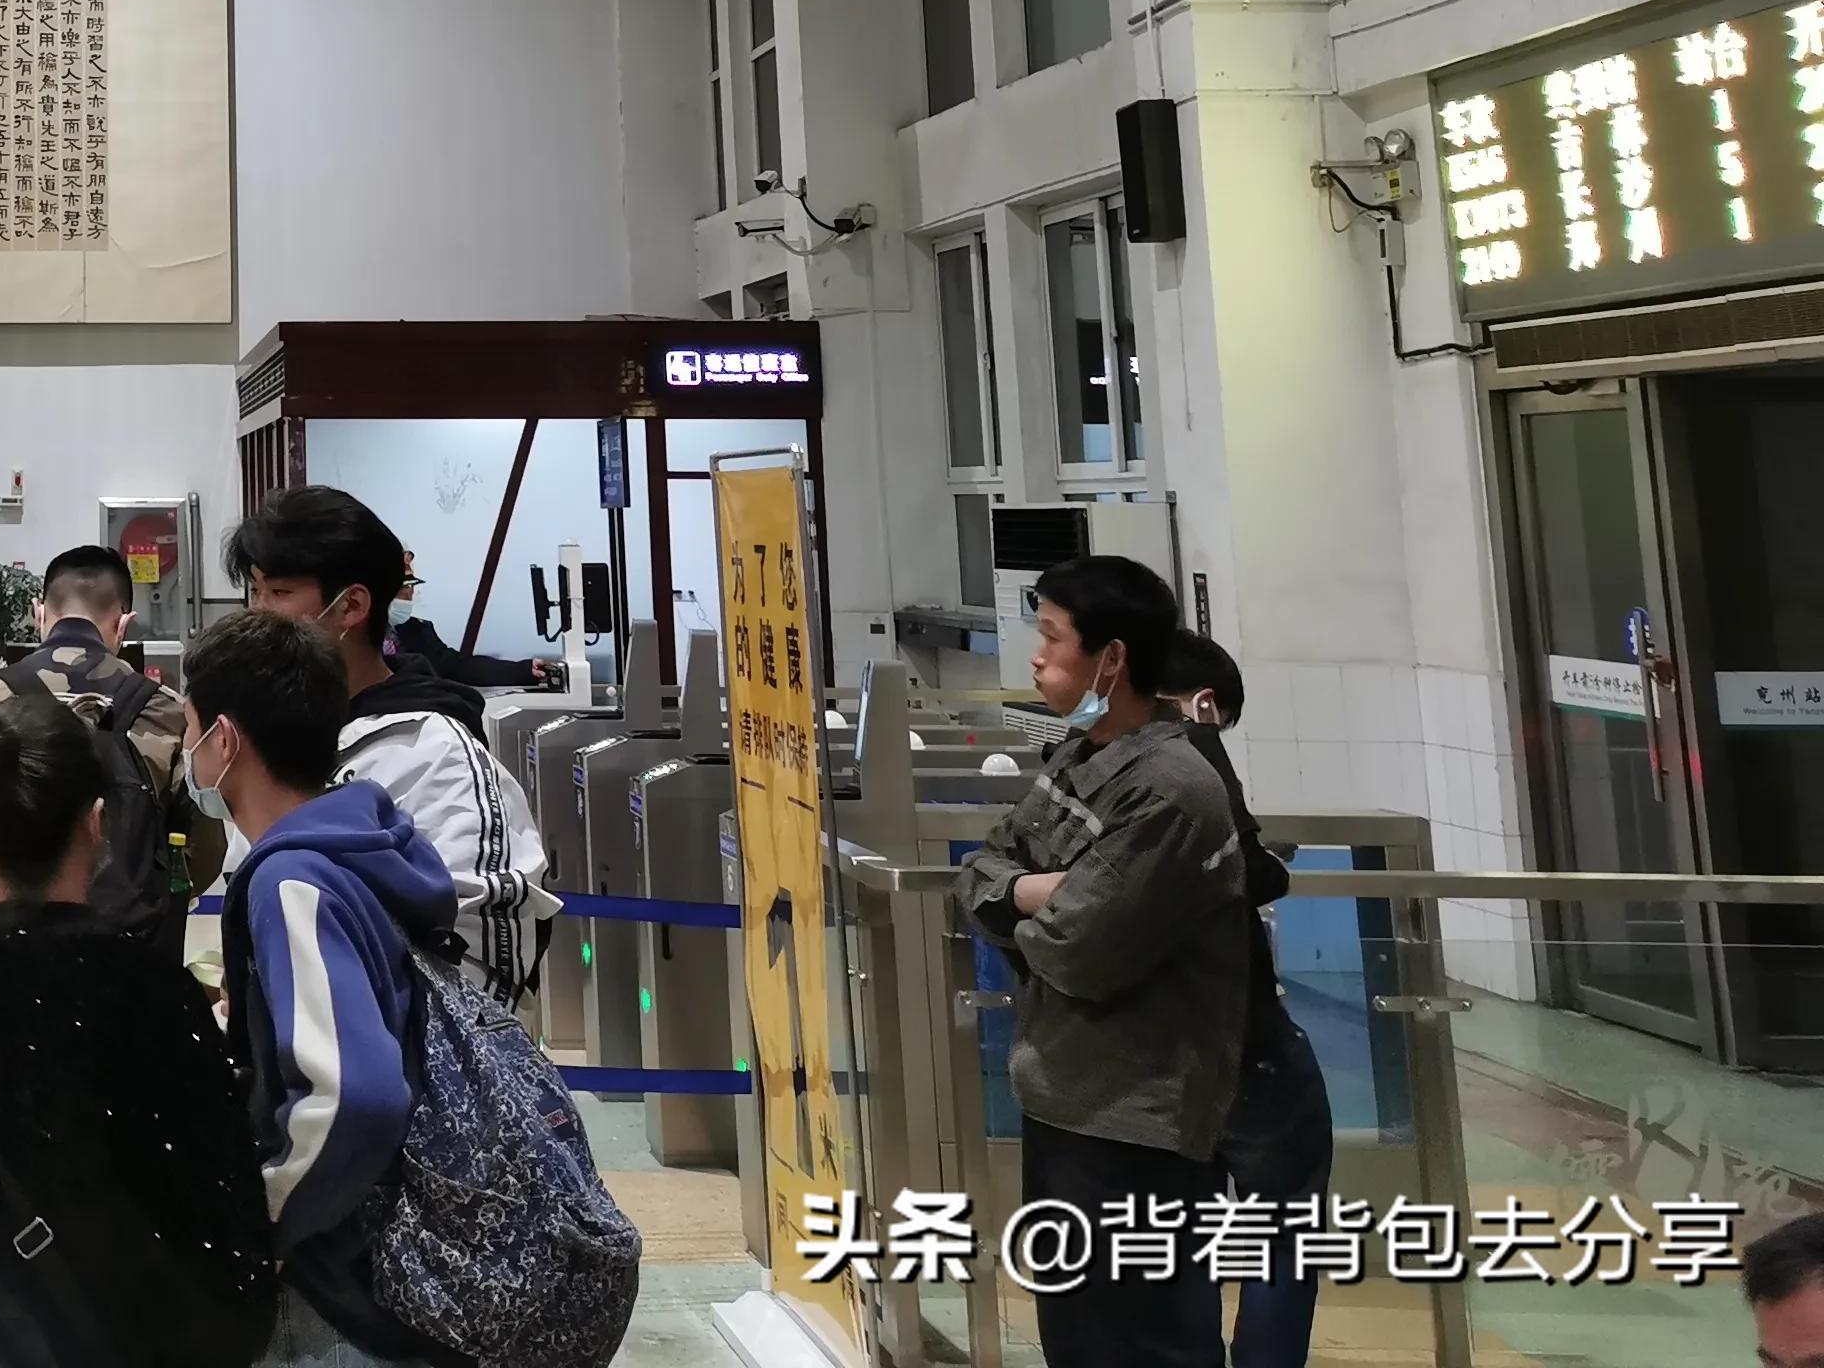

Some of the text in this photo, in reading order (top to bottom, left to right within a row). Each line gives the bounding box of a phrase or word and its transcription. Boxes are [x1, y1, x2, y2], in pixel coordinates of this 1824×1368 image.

[731, 540, 798, 611] 为了您
[734, 615, 803, 694] 的健康
